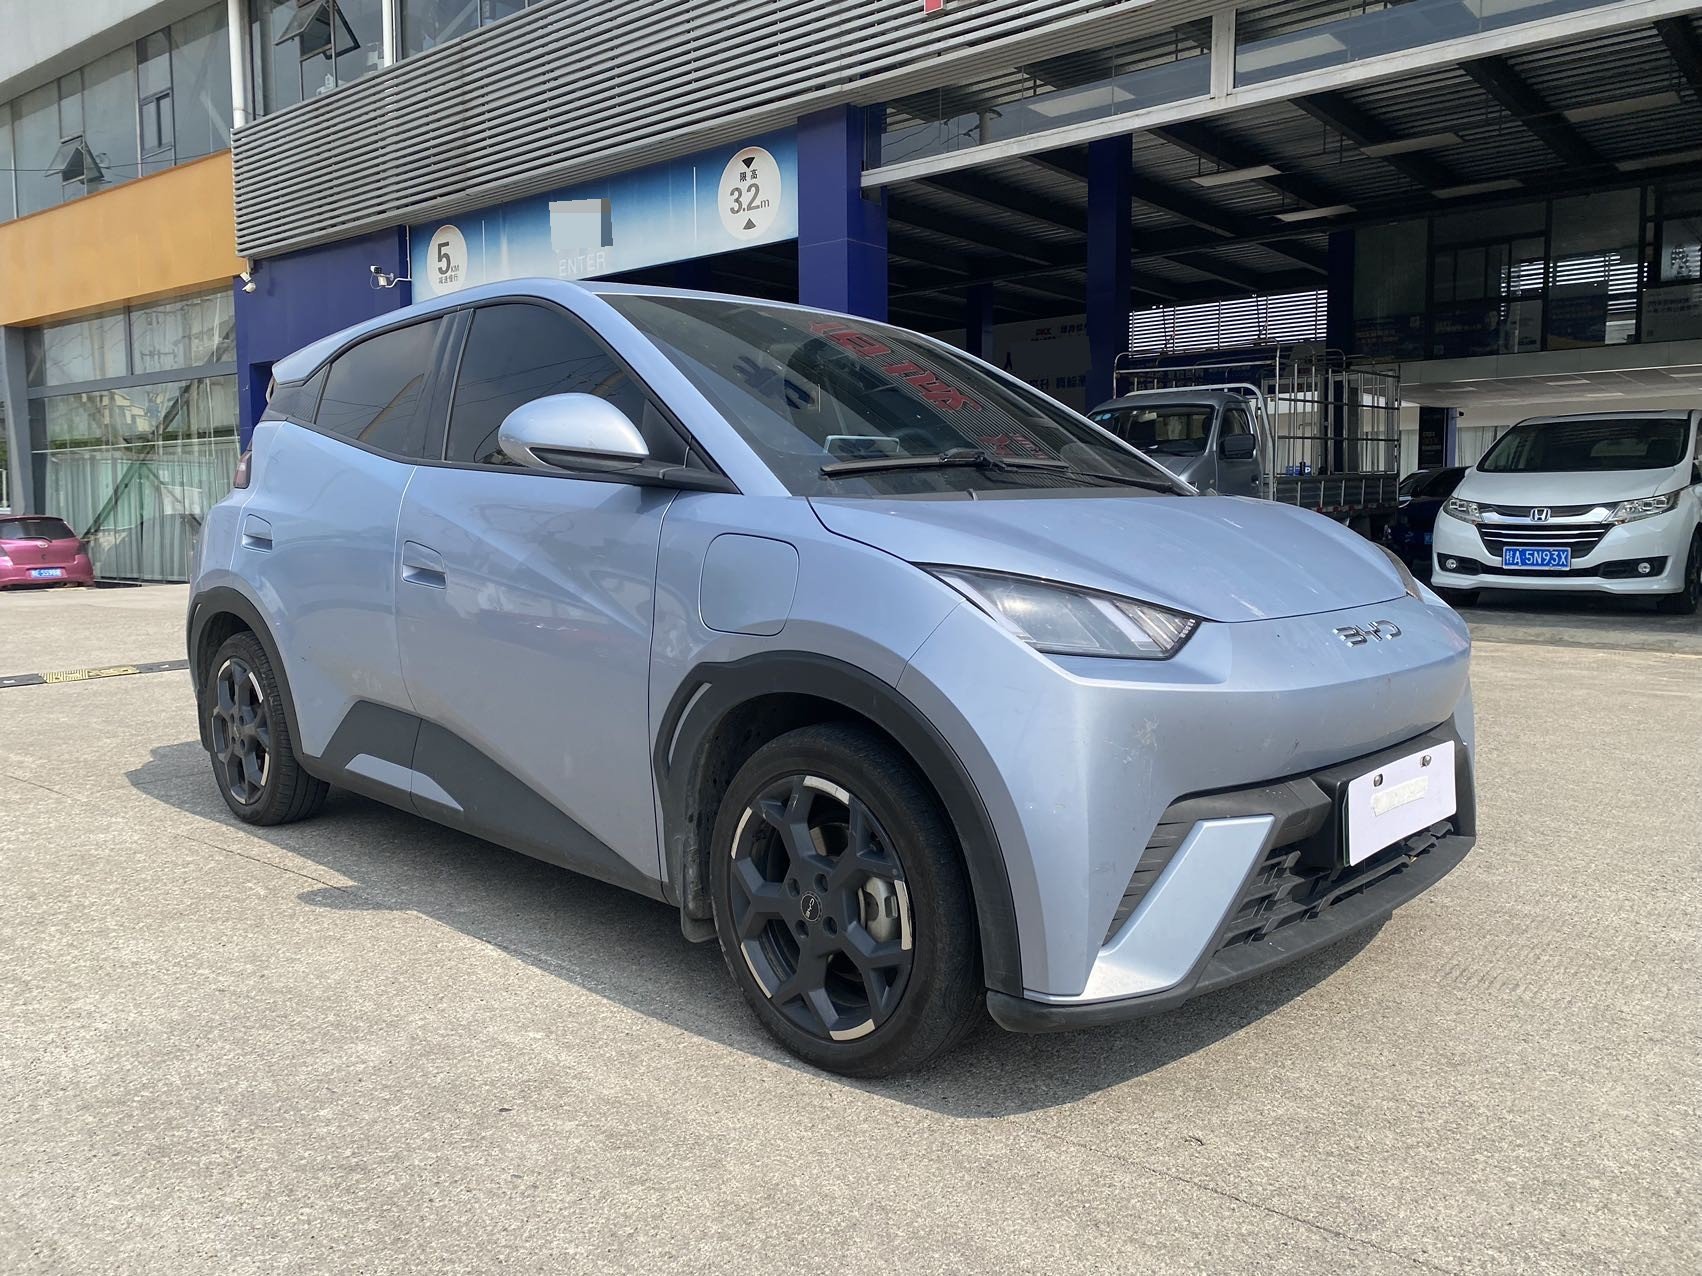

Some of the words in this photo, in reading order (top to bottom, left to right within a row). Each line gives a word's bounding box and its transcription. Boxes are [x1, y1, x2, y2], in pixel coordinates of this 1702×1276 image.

[739, 169, 758, 183] 限高
[729, 182, 770, 214] 3.2m
[559, 252, 605, 276] ENTER
[1332, 620, 1402, 648] BYD
